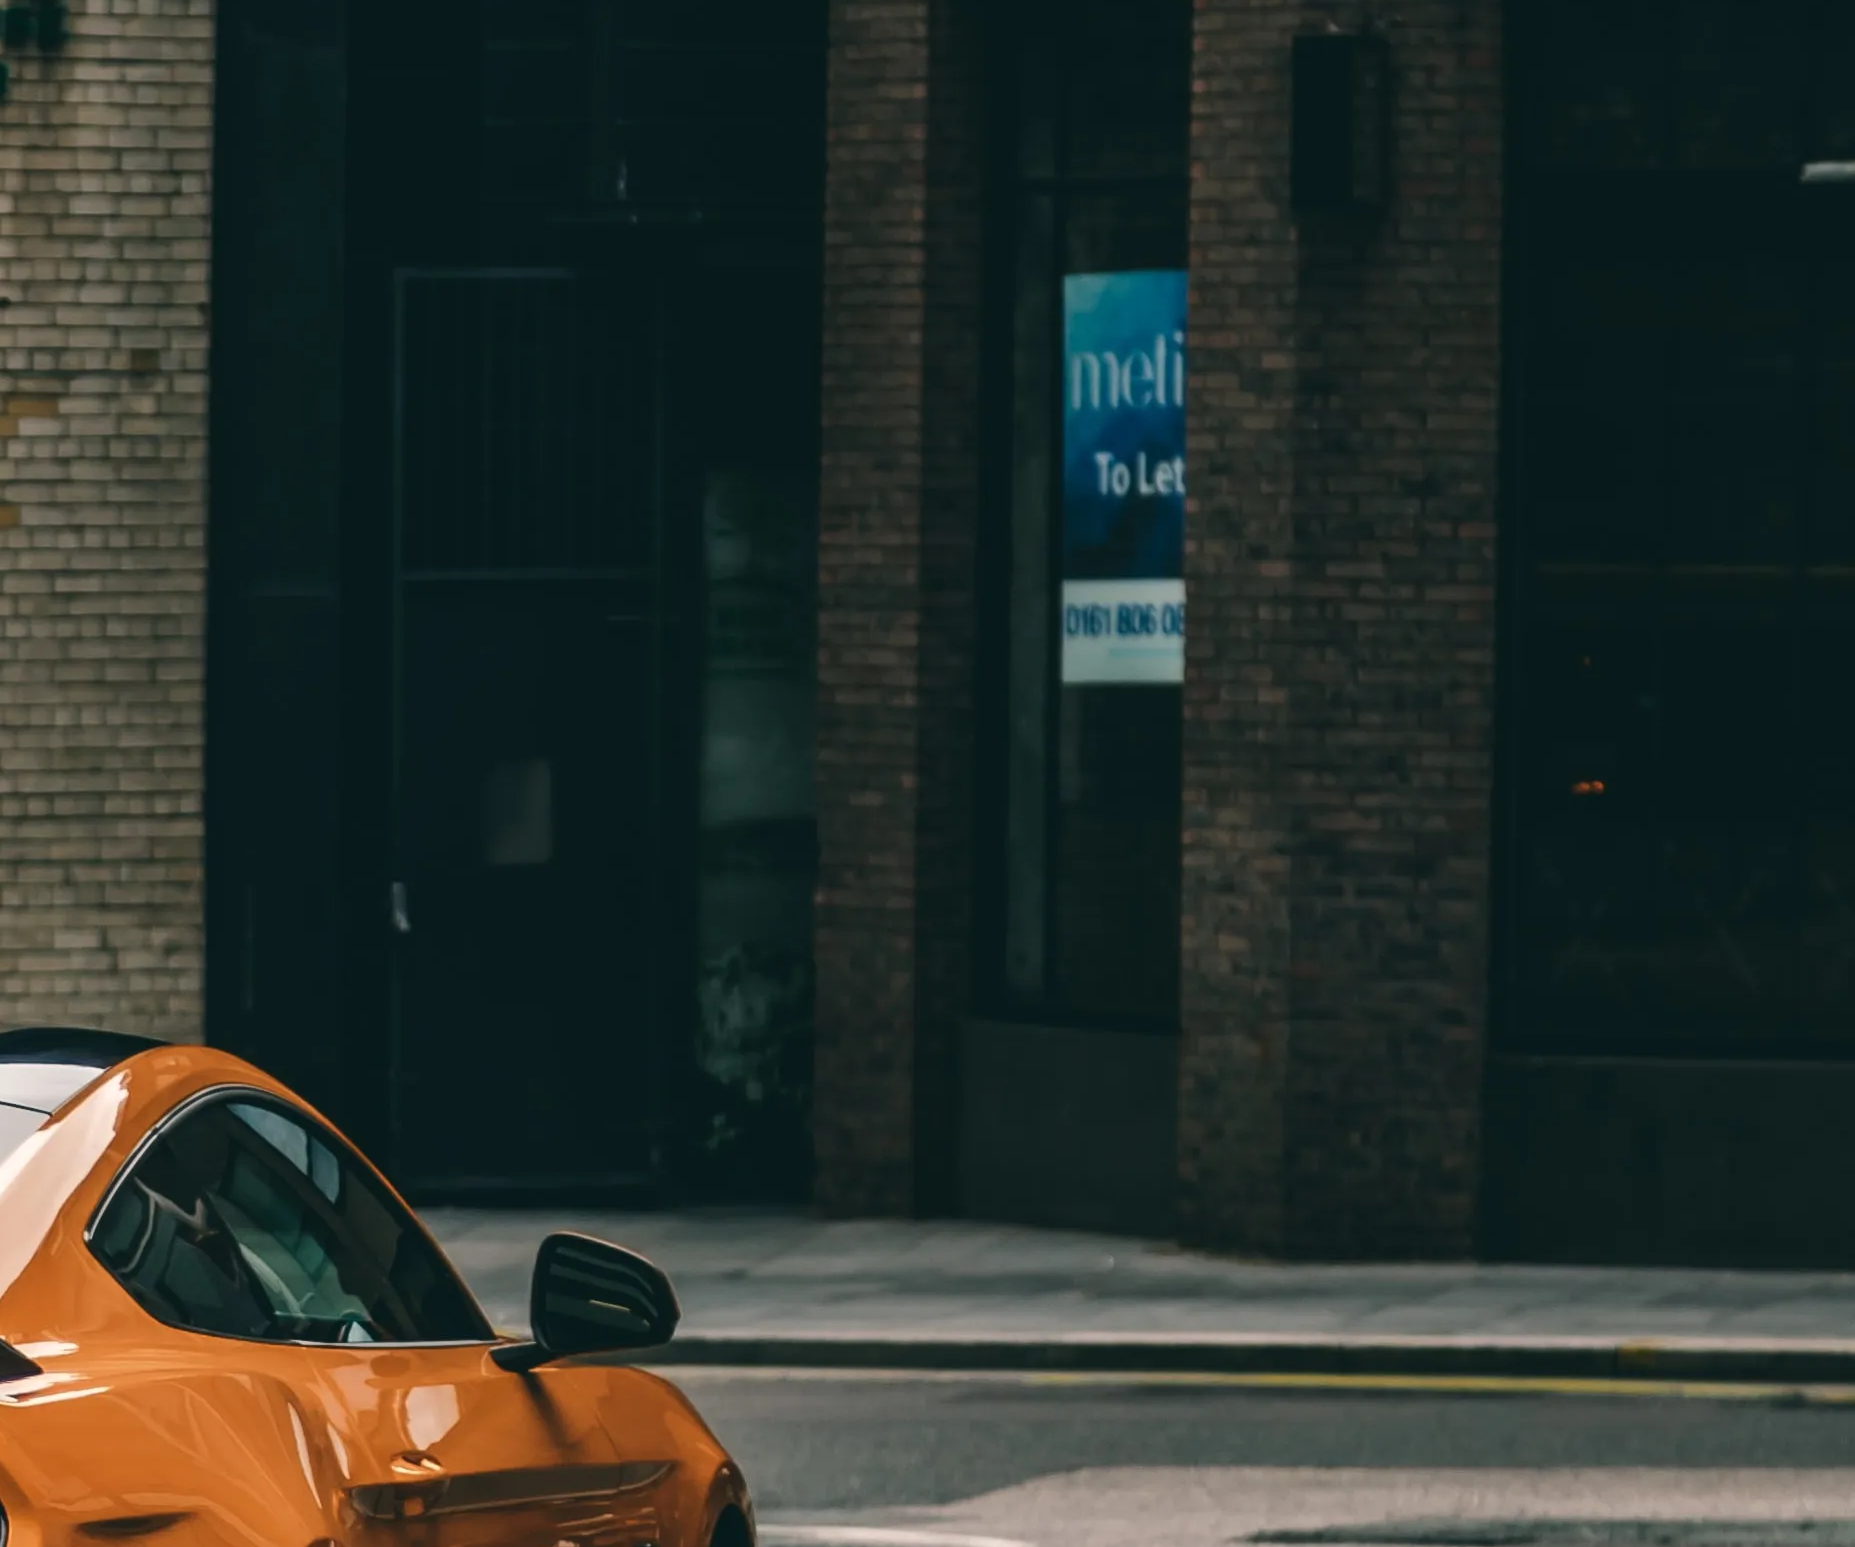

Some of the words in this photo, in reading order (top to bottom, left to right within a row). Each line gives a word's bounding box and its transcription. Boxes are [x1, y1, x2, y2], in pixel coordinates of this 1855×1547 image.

[1095, 451, 1131, 496] To
[1136, 451, 1186, 497] Let
[1066, 604, 1112, 636] 0161
[1118, 604, 1158, 636] 806
